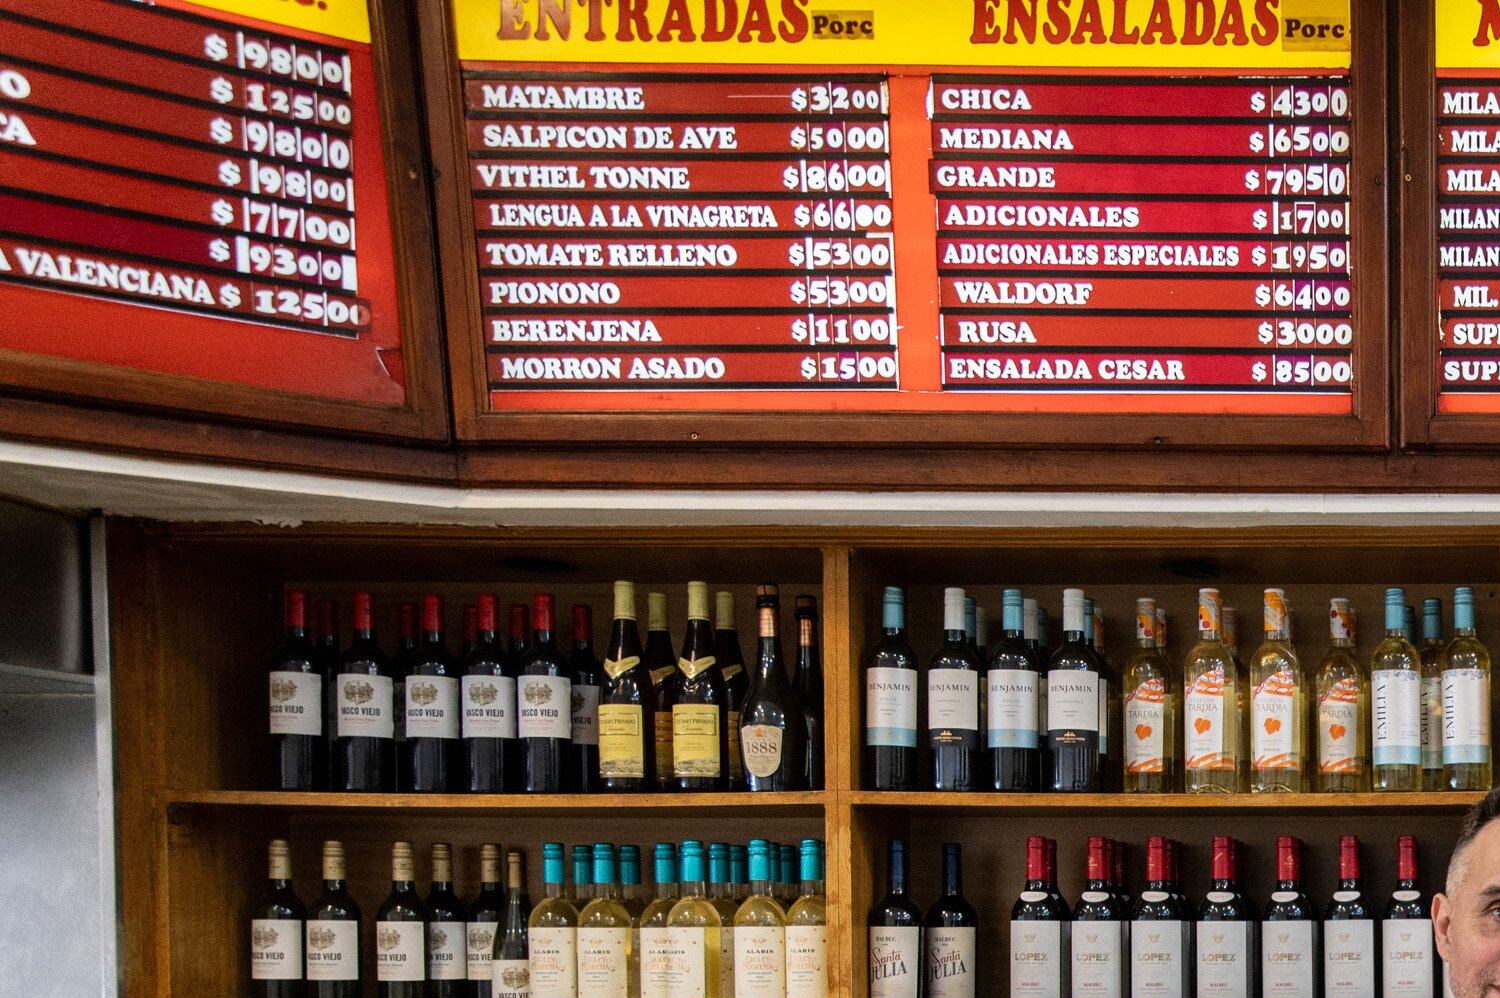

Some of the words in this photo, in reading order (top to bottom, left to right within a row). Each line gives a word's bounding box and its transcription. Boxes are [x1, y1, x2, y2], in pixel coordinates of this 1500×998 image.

[497, 0, 808, 43] ENTRADAS
[813, 15, 873, 35] Porc
[970, 0, 1280, 45] ENSALADAS
[1285, 18, 1344, 38] Porc
[481, 84, 645, 110] MATAMBRE
[941, 88, 1032, 110] CHICA
[483, 124, 628, 149] SALPICON
[633, 126, 675, 150] DE
[679, 126, 738, 150] AVE
[940, 127, 1074, 150] MEDIANA
[476, 164, 586, 189] VITHEL
[589, 165, 691, 190] TONNE
[936, 165, 1056, 188] GRANDE
[489, 203, 586, 227] LENGUA
[588, 204, 615, 228] A
[614, 204, 642, 228] LA
[645, 205, 779, 228] VINAGRETA
[944, 204, 1140, 228] ADICIONALES
[485, 243, 604, 267] TOMATE
[607, 244, 738, 267] RELLENO
[943, 243, 1099, 266] ADICIONALES
[1103, 244, 1240, 267] ESPECIALES
[14, 247, 216, 305] VALENCIANA
[489, 281, 621, 305] PIONONO
[953, 281, 1093, 305] WALDORF
[1453, 285, 1499, 308] MIL.
[491, 319, 663, 343] BERENJENA
[958, 321, 1037, 344] RUSA
[501, 357, 622, 380] MORRON
[627, 356, 726, 380] ASADO
[949, 358, 1093, 380] ENSALADA
[1097, 359, 1185, 381] CESAR
[868, 683, 911, 692] BENJAMIN
[929, 684, 970, 692] BENJAMIN
[991, 685, 1033, 693] BENJAMIN
[1051, 685, 1092, 693] BENJAMIN
